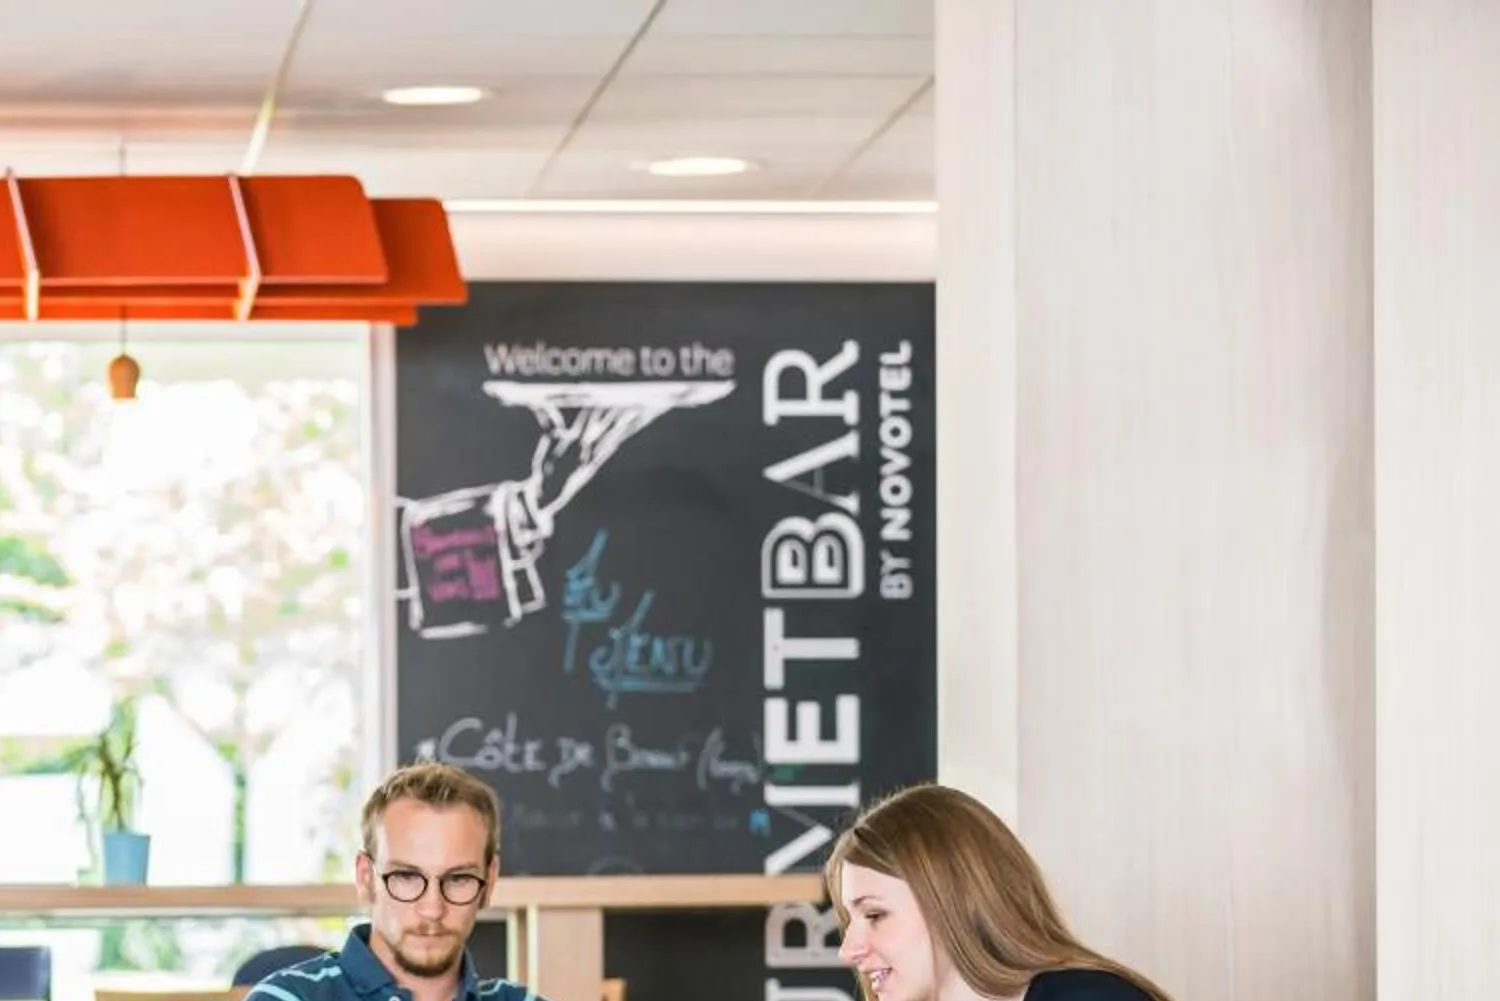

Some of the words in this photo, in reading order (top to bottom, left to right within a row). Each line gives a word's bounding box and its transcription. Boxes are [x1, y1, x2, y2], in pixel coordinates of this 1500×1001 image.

[483, 341, 636, 377] Welcome
[639, 346, 675, 377] to
[679, 342, 735, 377] the
[762, 340, 865, 598] BAR
[879, 340, 912, 541] NOVOTEL
[879, 550, 912, 598] BY
